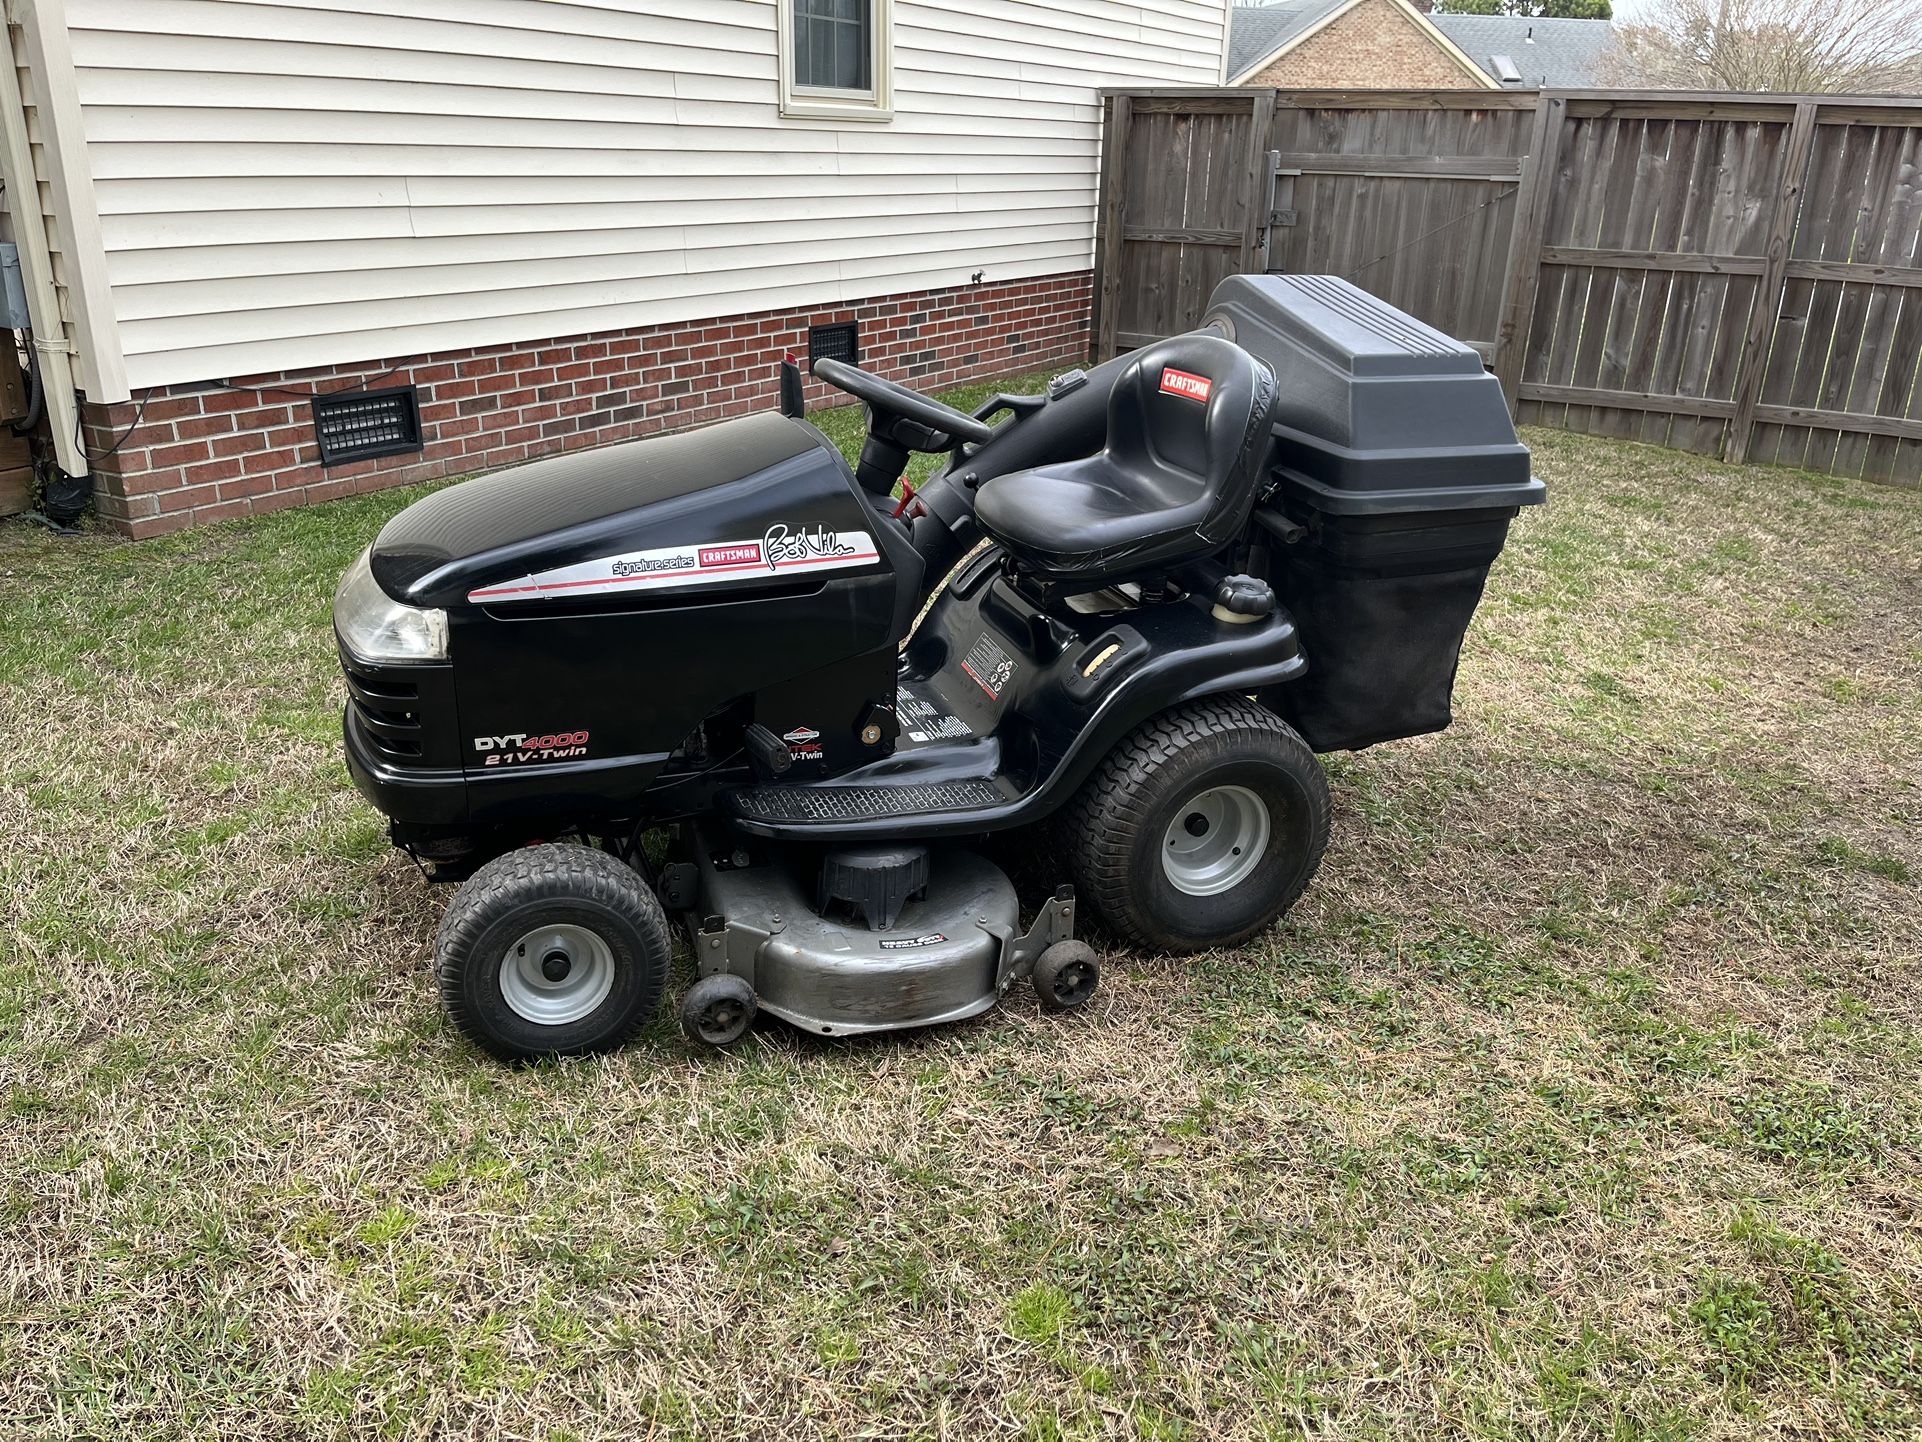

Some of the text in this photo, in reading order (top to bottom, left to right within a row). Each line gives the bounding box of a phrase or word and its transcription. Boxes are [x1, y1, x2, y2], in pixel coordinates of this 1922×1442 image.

[1163, 373, 1209, 397] CRAFTSMAN
[612, 555, 695, 576] signature series
[702, 548, 757, 563] CRAFTSMAN
